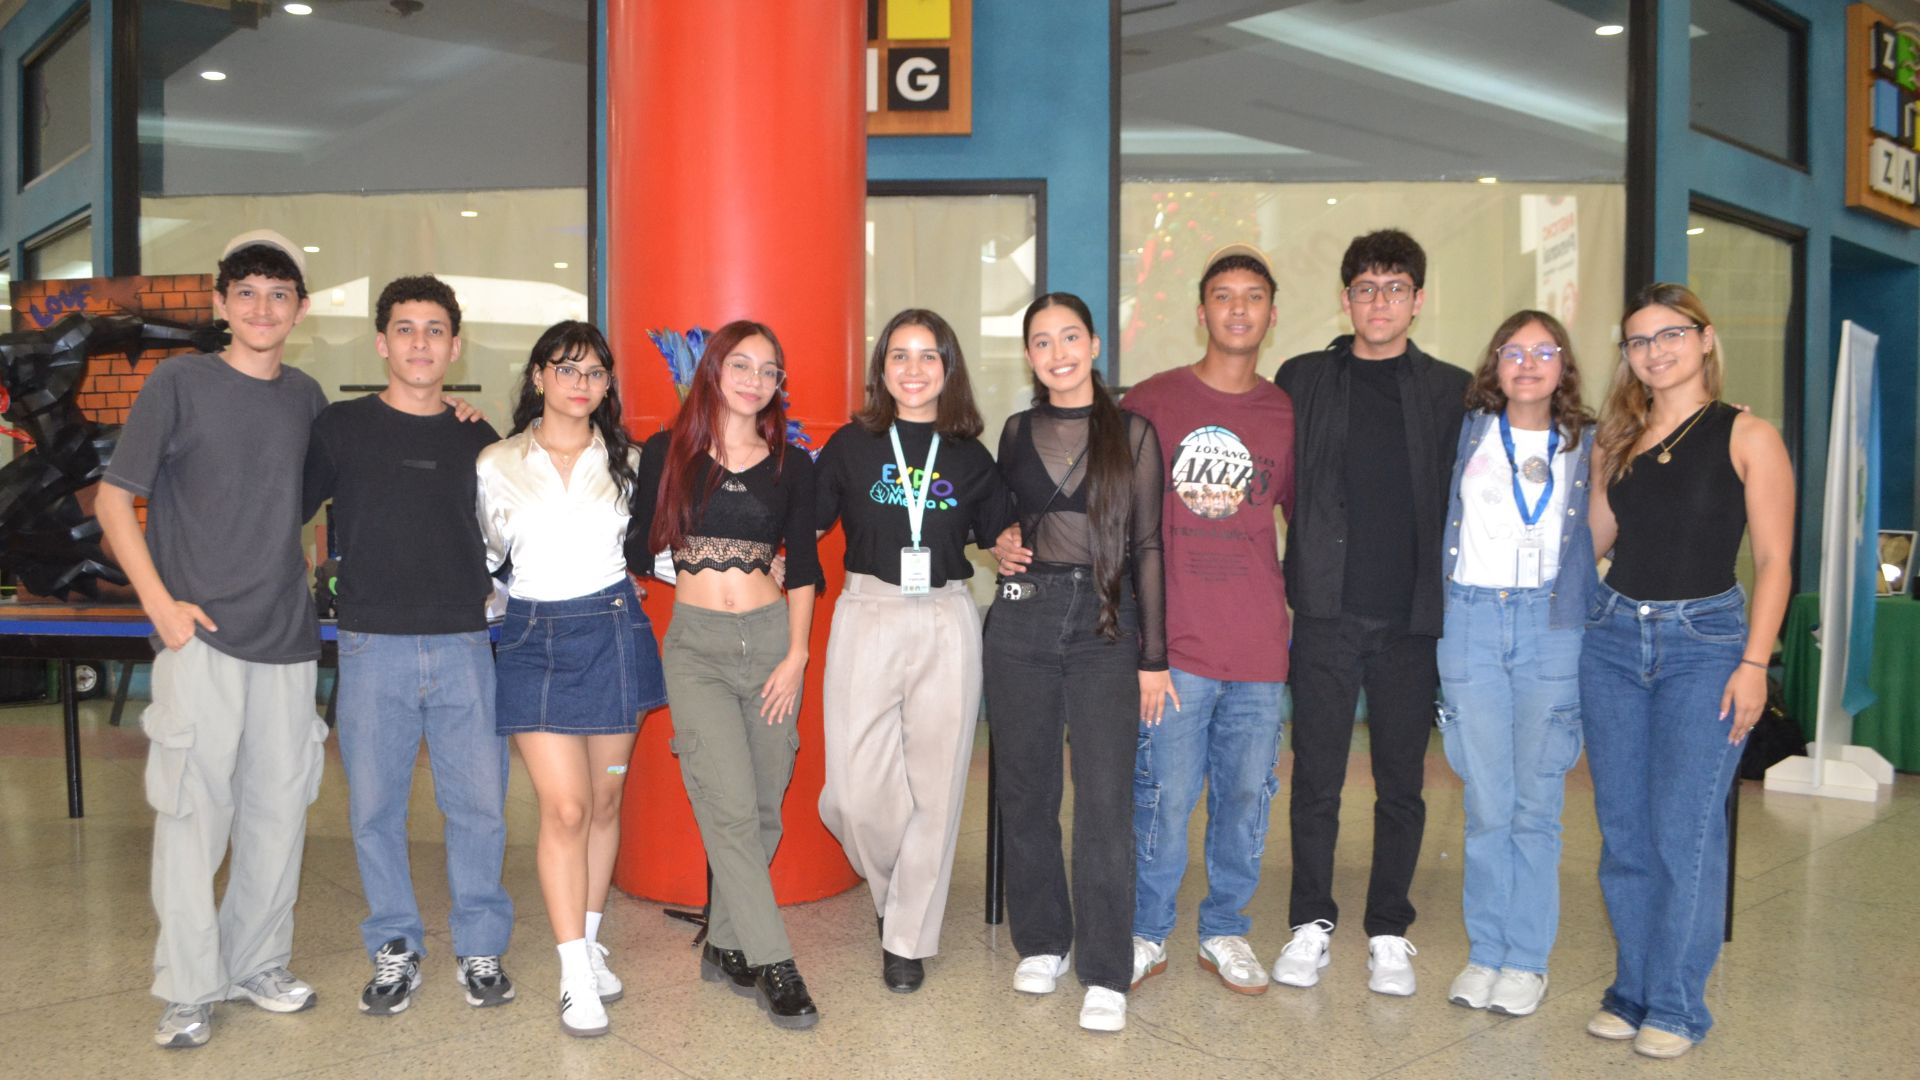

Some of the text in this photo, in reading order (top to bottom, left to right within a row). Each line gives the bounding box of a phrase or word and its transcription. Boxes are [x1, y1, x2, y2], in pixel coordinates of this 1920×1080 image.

[896, 57, 940, 102] G
[1882, 151, 1920, 194] ZA
[1195, 445, 1219, 454] LOS
[1167, 444, 1272, 506] LAKERS
[888, 493, 936, 509] Mea
